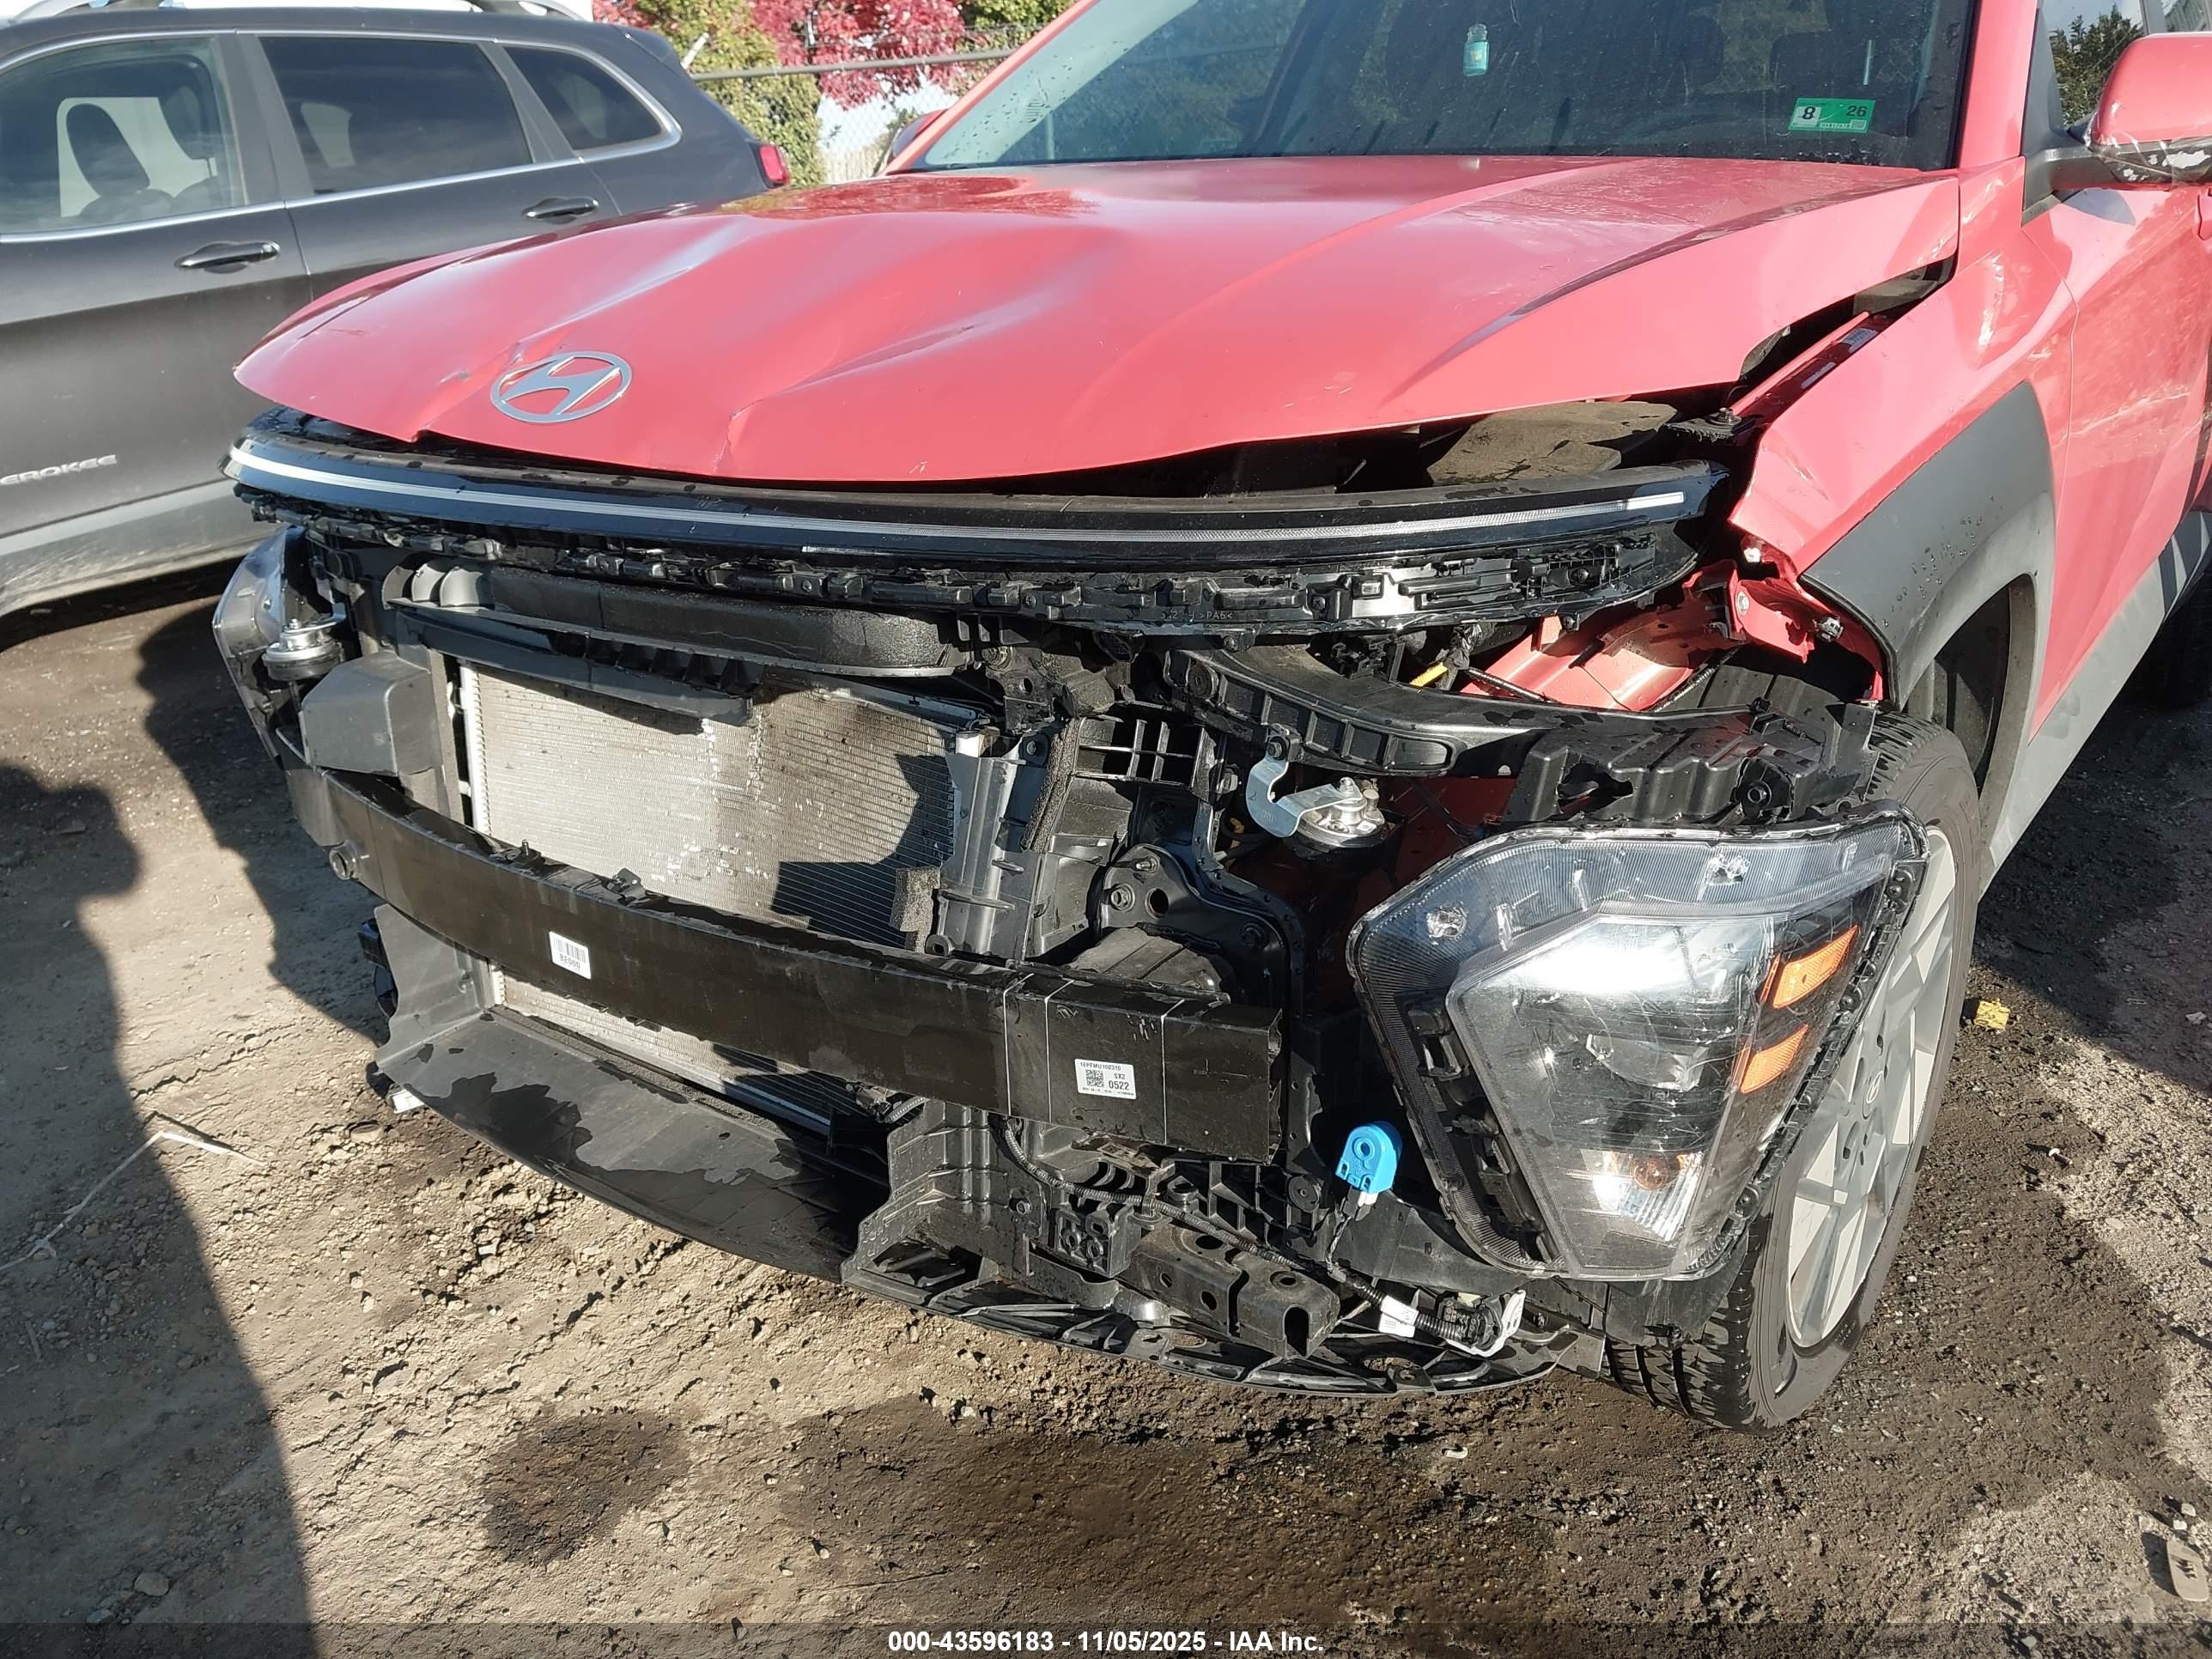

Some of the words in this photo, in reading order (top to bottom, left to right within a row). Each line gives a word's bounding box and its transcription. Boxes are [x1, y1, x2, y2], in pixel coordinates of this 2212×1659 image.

[1802, 106, 1816, 120] 8
[1846, 105, 1869, 118] 26
[1108, 1080, 1130, 1091] 0522
